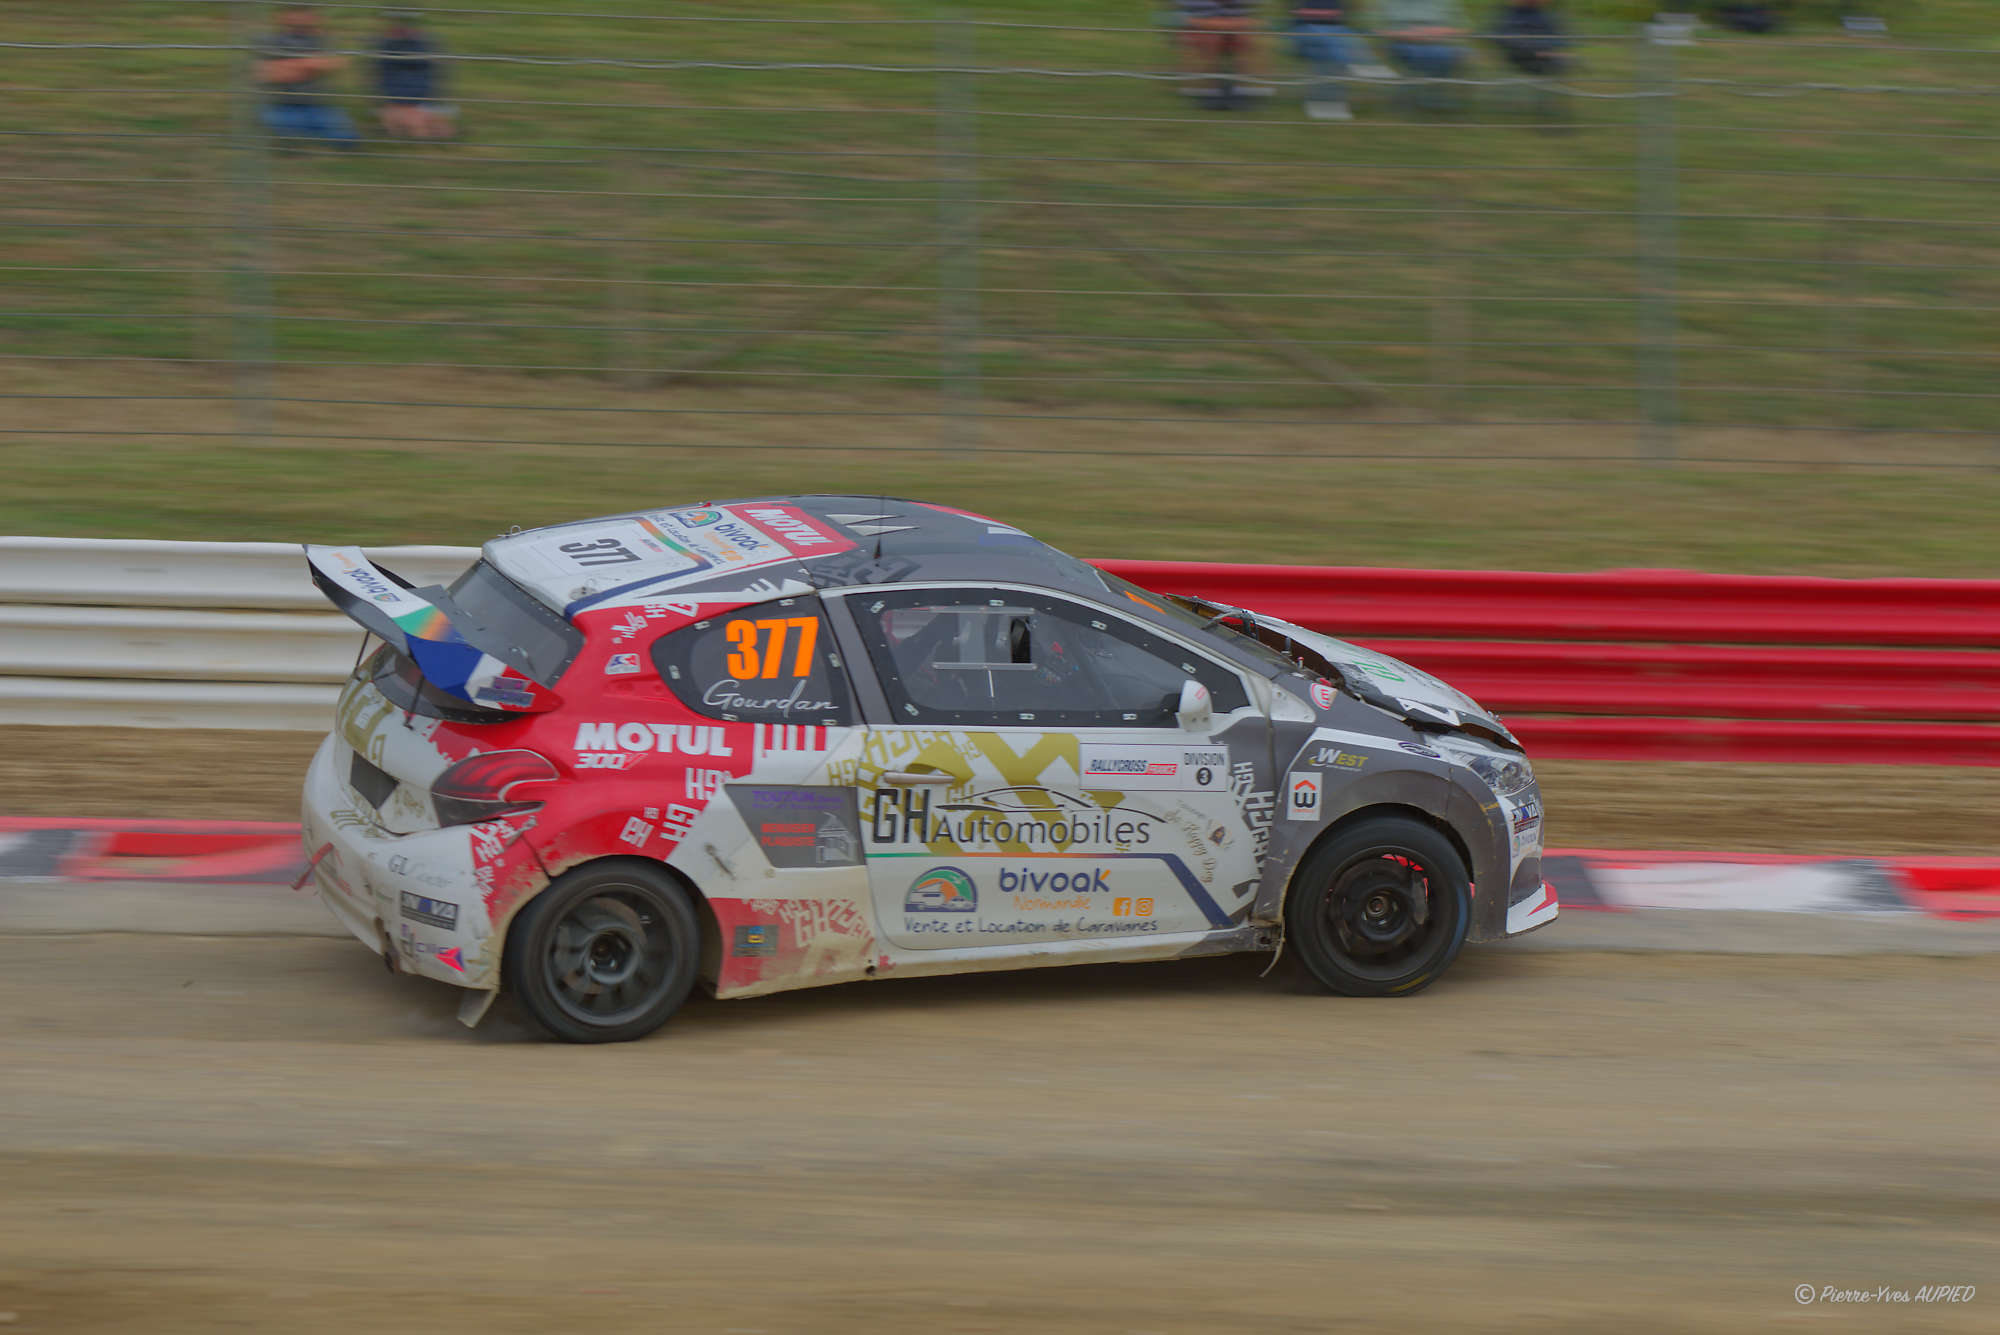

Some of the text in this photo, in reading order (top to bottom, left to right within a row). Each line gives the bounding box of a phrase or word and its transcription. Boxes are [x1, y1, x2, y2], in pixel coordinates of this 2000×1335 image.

[744, 508, 833, 546] MOTUL
[559, 538, 643, 567] 377
[725, 616, 819, 680] 377
[702, 679, 839, 718] Gourdan
[573, 721, 734, 757] MOTUL
[1089, 759, 1148, 773] RALLYCROSS
[1184, 752, 1225, 767] DIVISION
[1197, 767, 1211, 785] 3
[873, 788, 1150, 846] GH Automobiles
[999, 867, 1111, 892] bivoak
[903, 916, 950, 935] Vente
[953, 918, 973, 934] et
[978, 915, 1048, 934] Location
[1076, 913, 1158, 934] Caravanes
